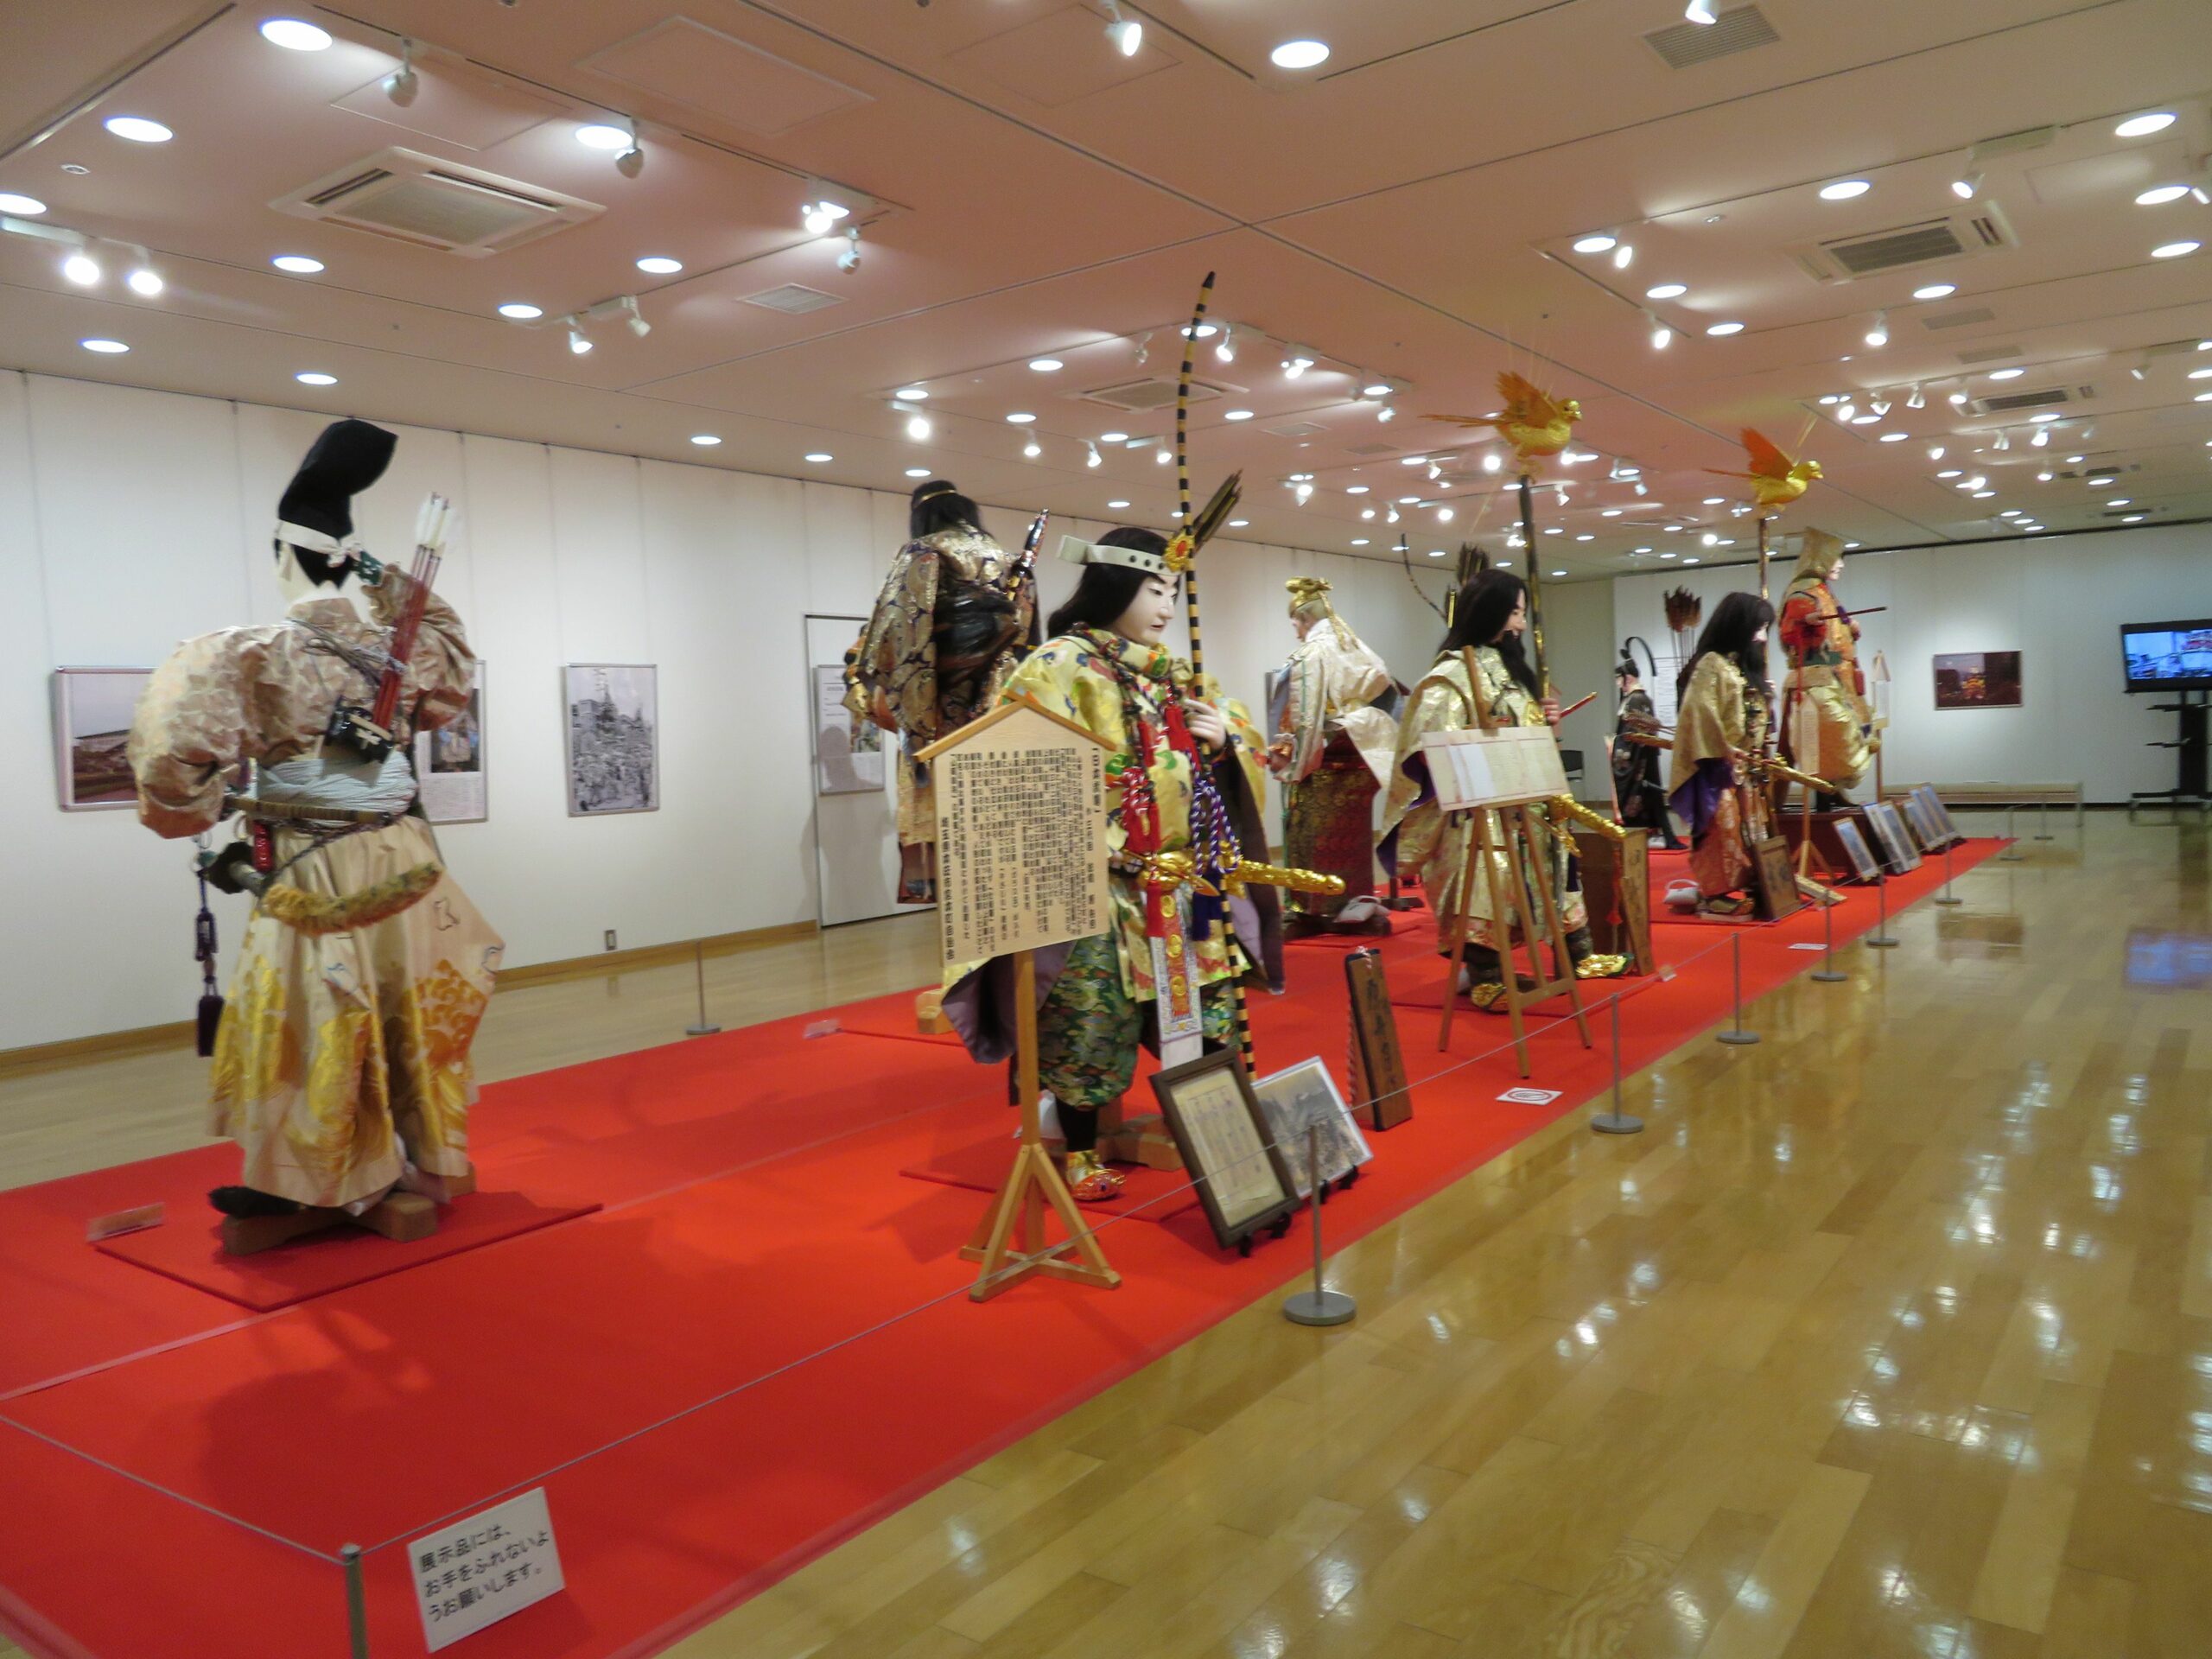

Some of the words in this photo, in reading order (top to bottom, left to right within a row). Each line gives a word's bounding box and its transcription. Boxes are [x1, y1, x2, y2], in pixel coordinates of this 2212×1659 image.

[419, 1523, 512, 1573] 展示品には、
[424, 1530, 550, 1598] お手をふれないよ
[428, 1561, 543, 1623] うお願いします。
